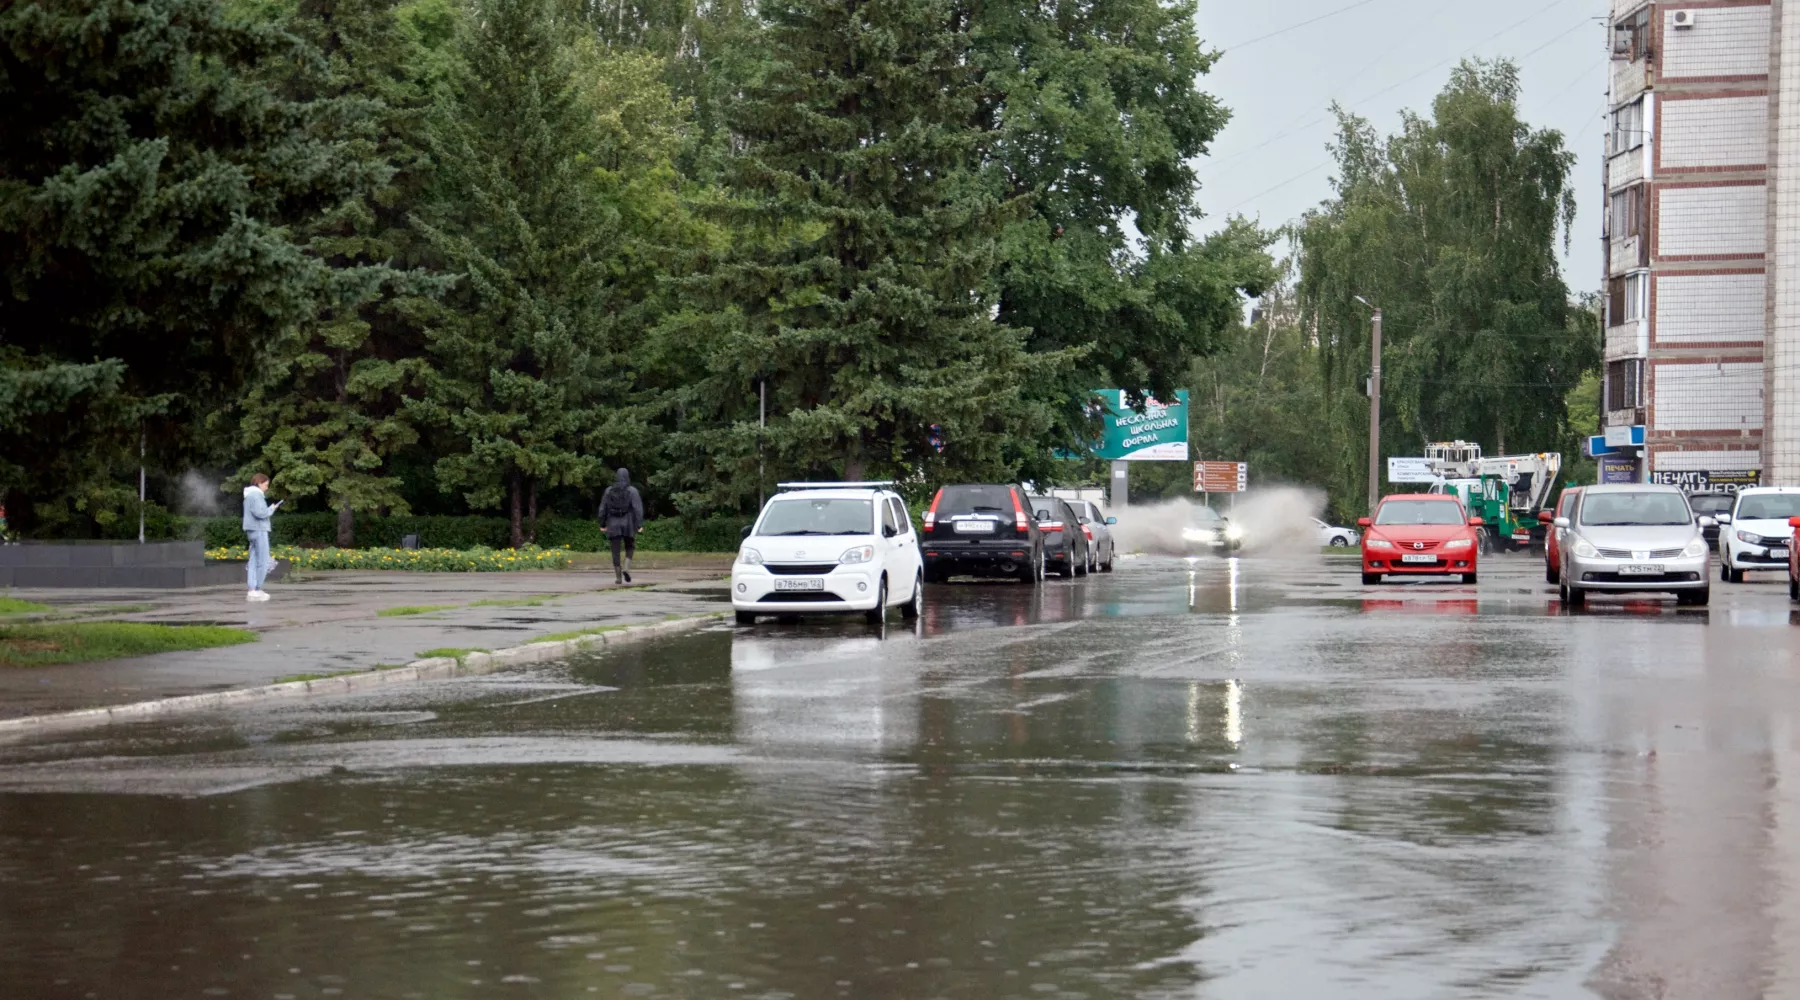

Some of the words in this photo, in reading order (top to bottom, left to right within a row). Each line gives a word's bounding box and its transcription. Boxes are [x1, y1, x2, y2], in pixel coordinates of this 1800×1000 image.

[1130, 419, 1179, 435] ШКОЛЬНАЯ
[1122, 433, 1158, 448] ФОРМА
[1604, 464, 1635, 472] ПЕЧАТЬ
[1653, 471, 1707, 484] ПЕЧАТЬ
